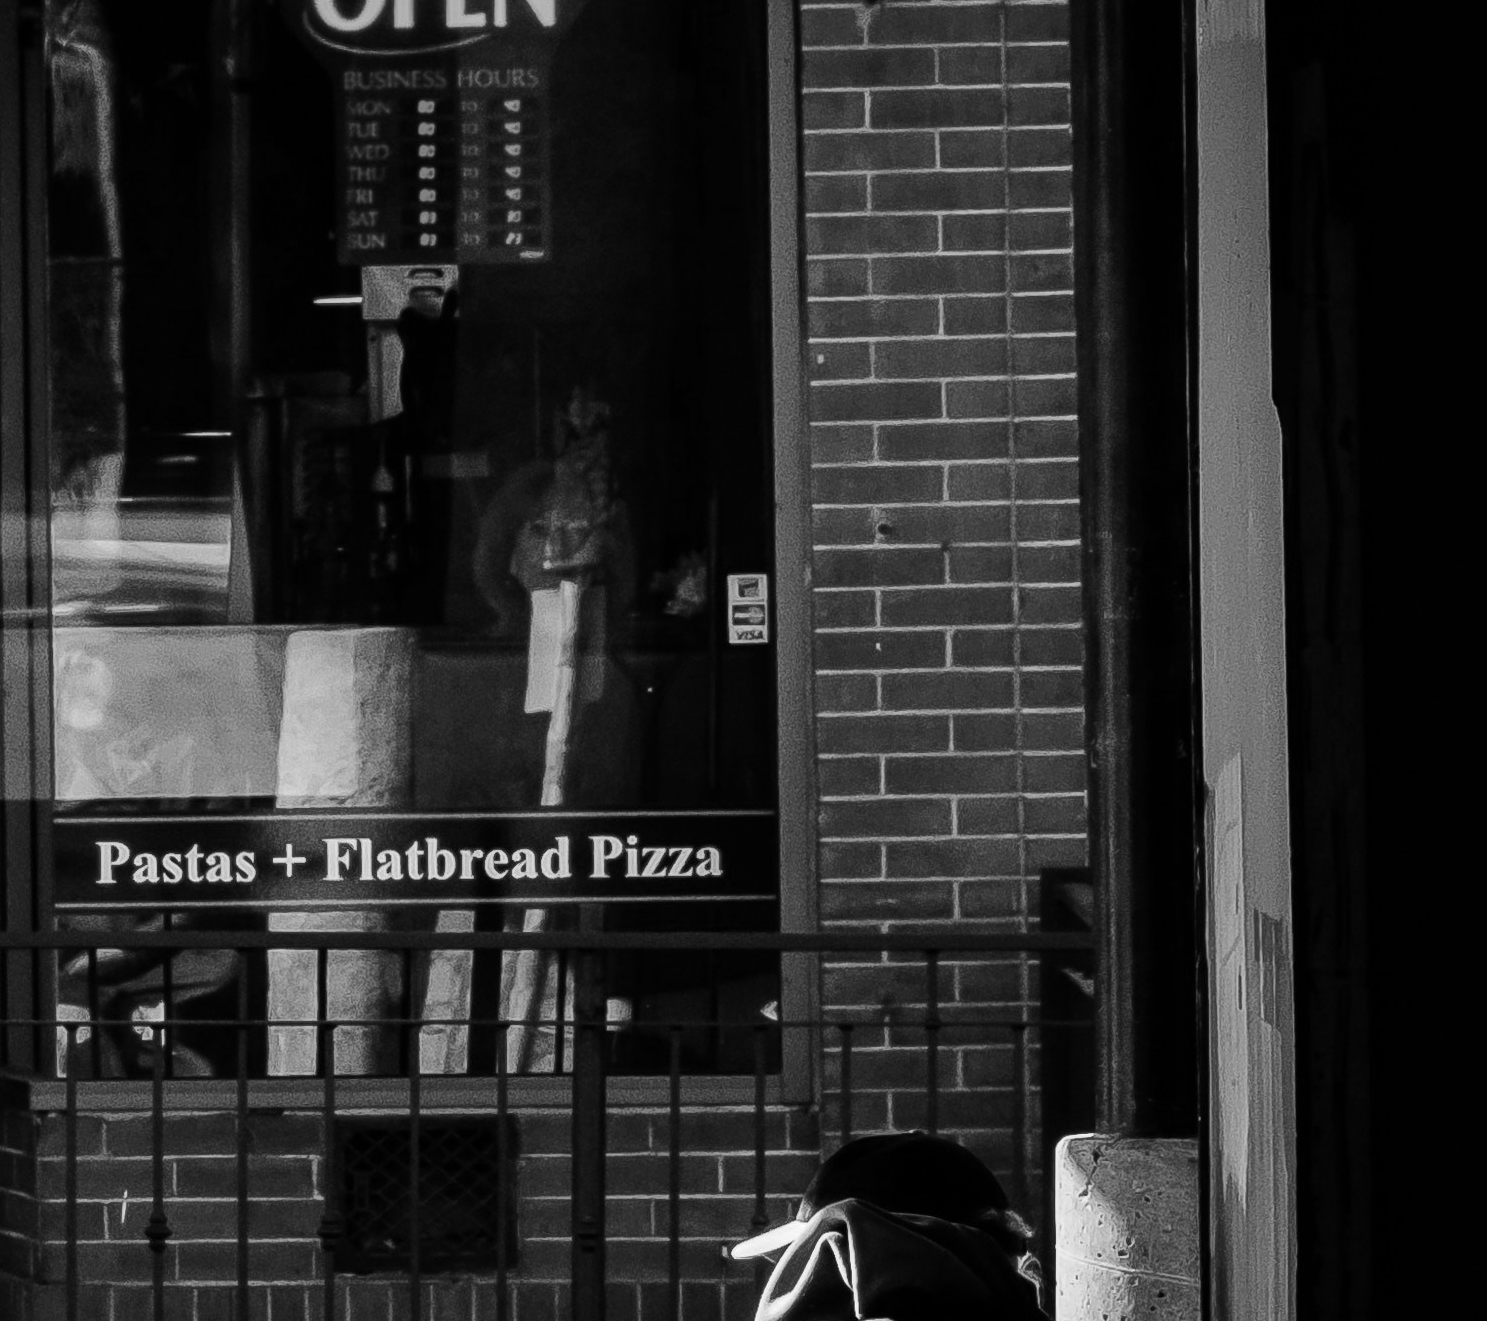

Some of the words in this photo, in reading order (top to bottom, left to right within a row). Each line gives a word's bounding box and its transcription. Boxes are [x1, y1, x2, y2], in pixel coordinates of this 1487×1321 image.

[343, 70, 447, 91] BUSINESS
[458, 68, 539, 88] HOURS
[347, 211, 378, 227] SAT
[347, 233, 386, 248] SUN
[95, 841, 257, 884] Pastas
[273, 843, 306, 878] +
[322, 836, 572, 881] Flatbread
[589, 834, 724, 878] Pizza
